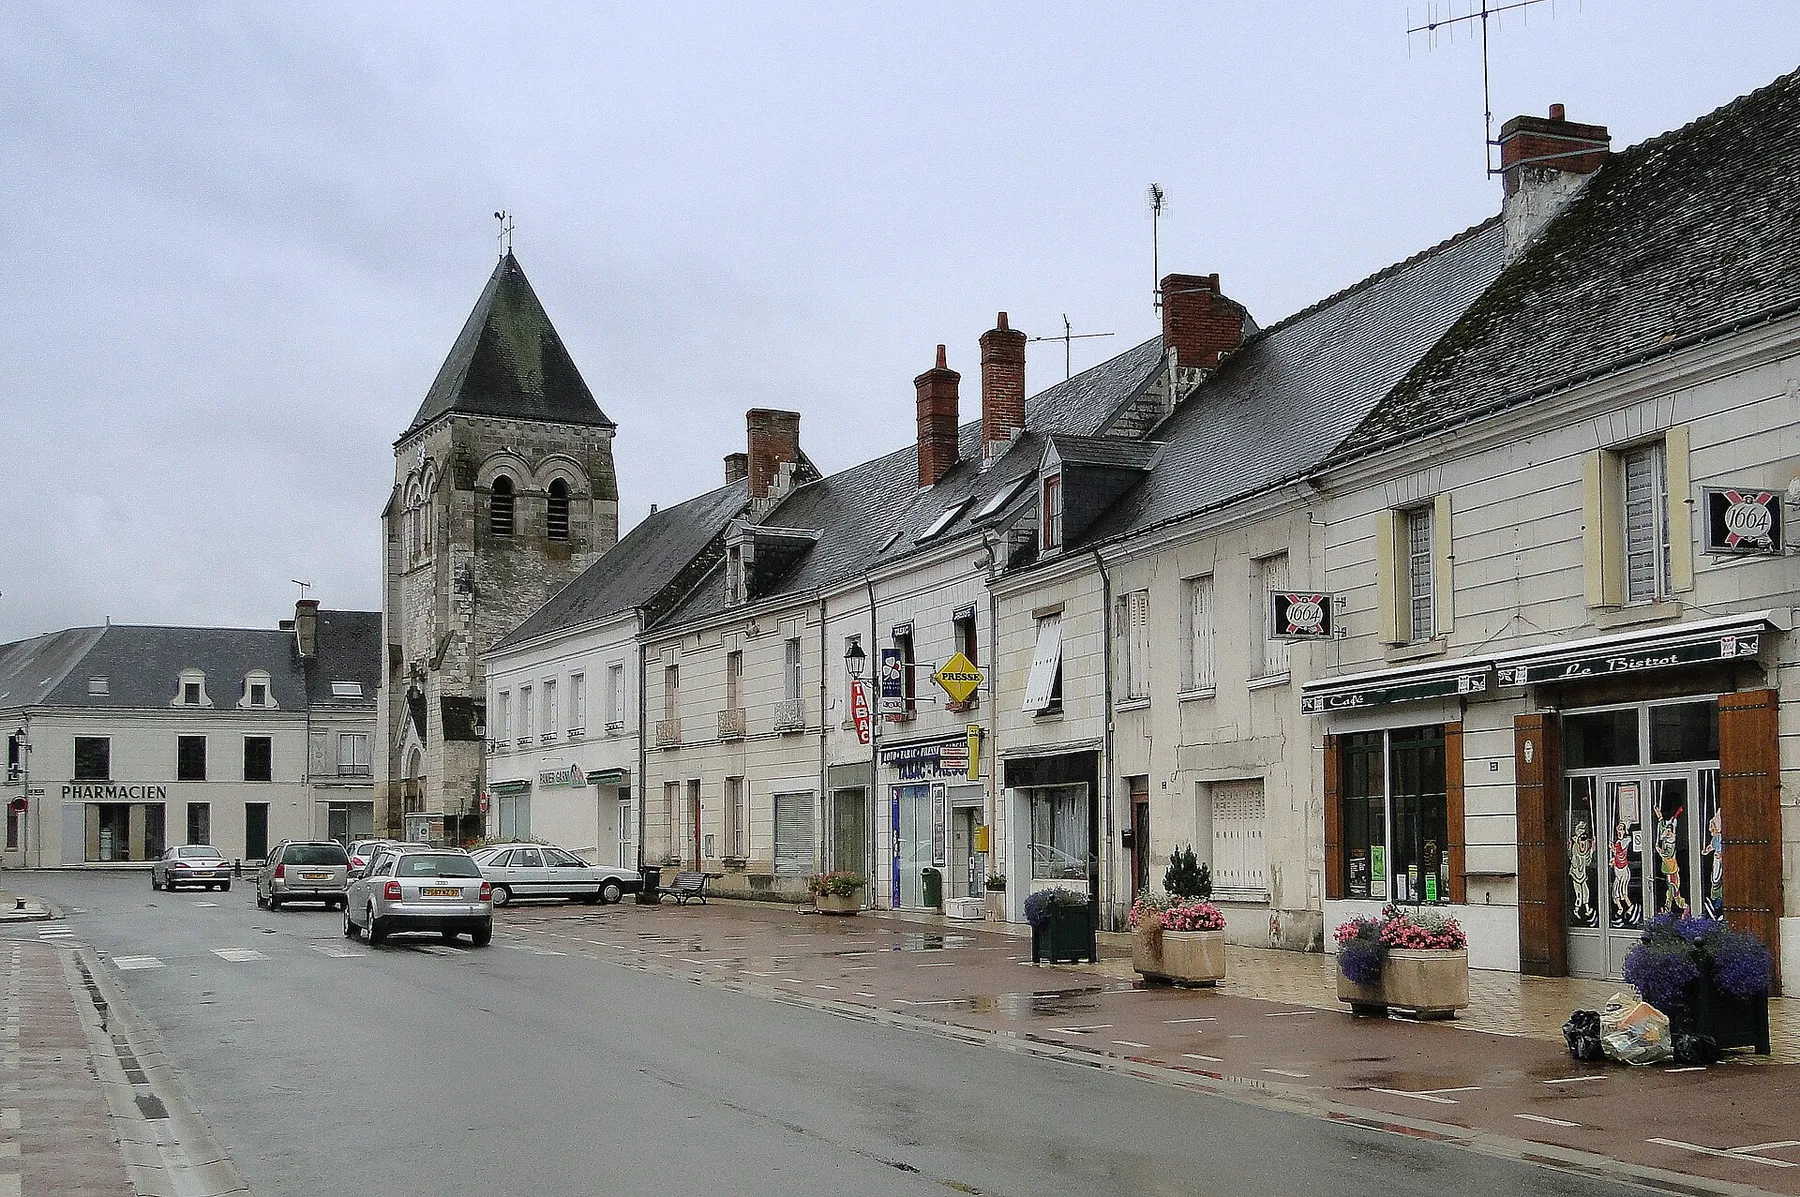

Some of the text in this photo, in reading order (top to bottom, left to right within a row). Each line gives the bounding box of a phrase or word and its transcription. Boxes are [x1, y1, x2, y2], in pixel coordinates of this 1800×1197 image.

[1729, 506, 1768, 531] 1664
[1289, 605, 1320, 622] 1664
[1559, 655, 1679, 678] Le Bistrot
[941, 672, 980, 681] PRESSE
[1330, 695, 1364, 707] Café
[855, 683, 869, 741] TABAC
[61, 785, 166, 799] PHARMACIEN
